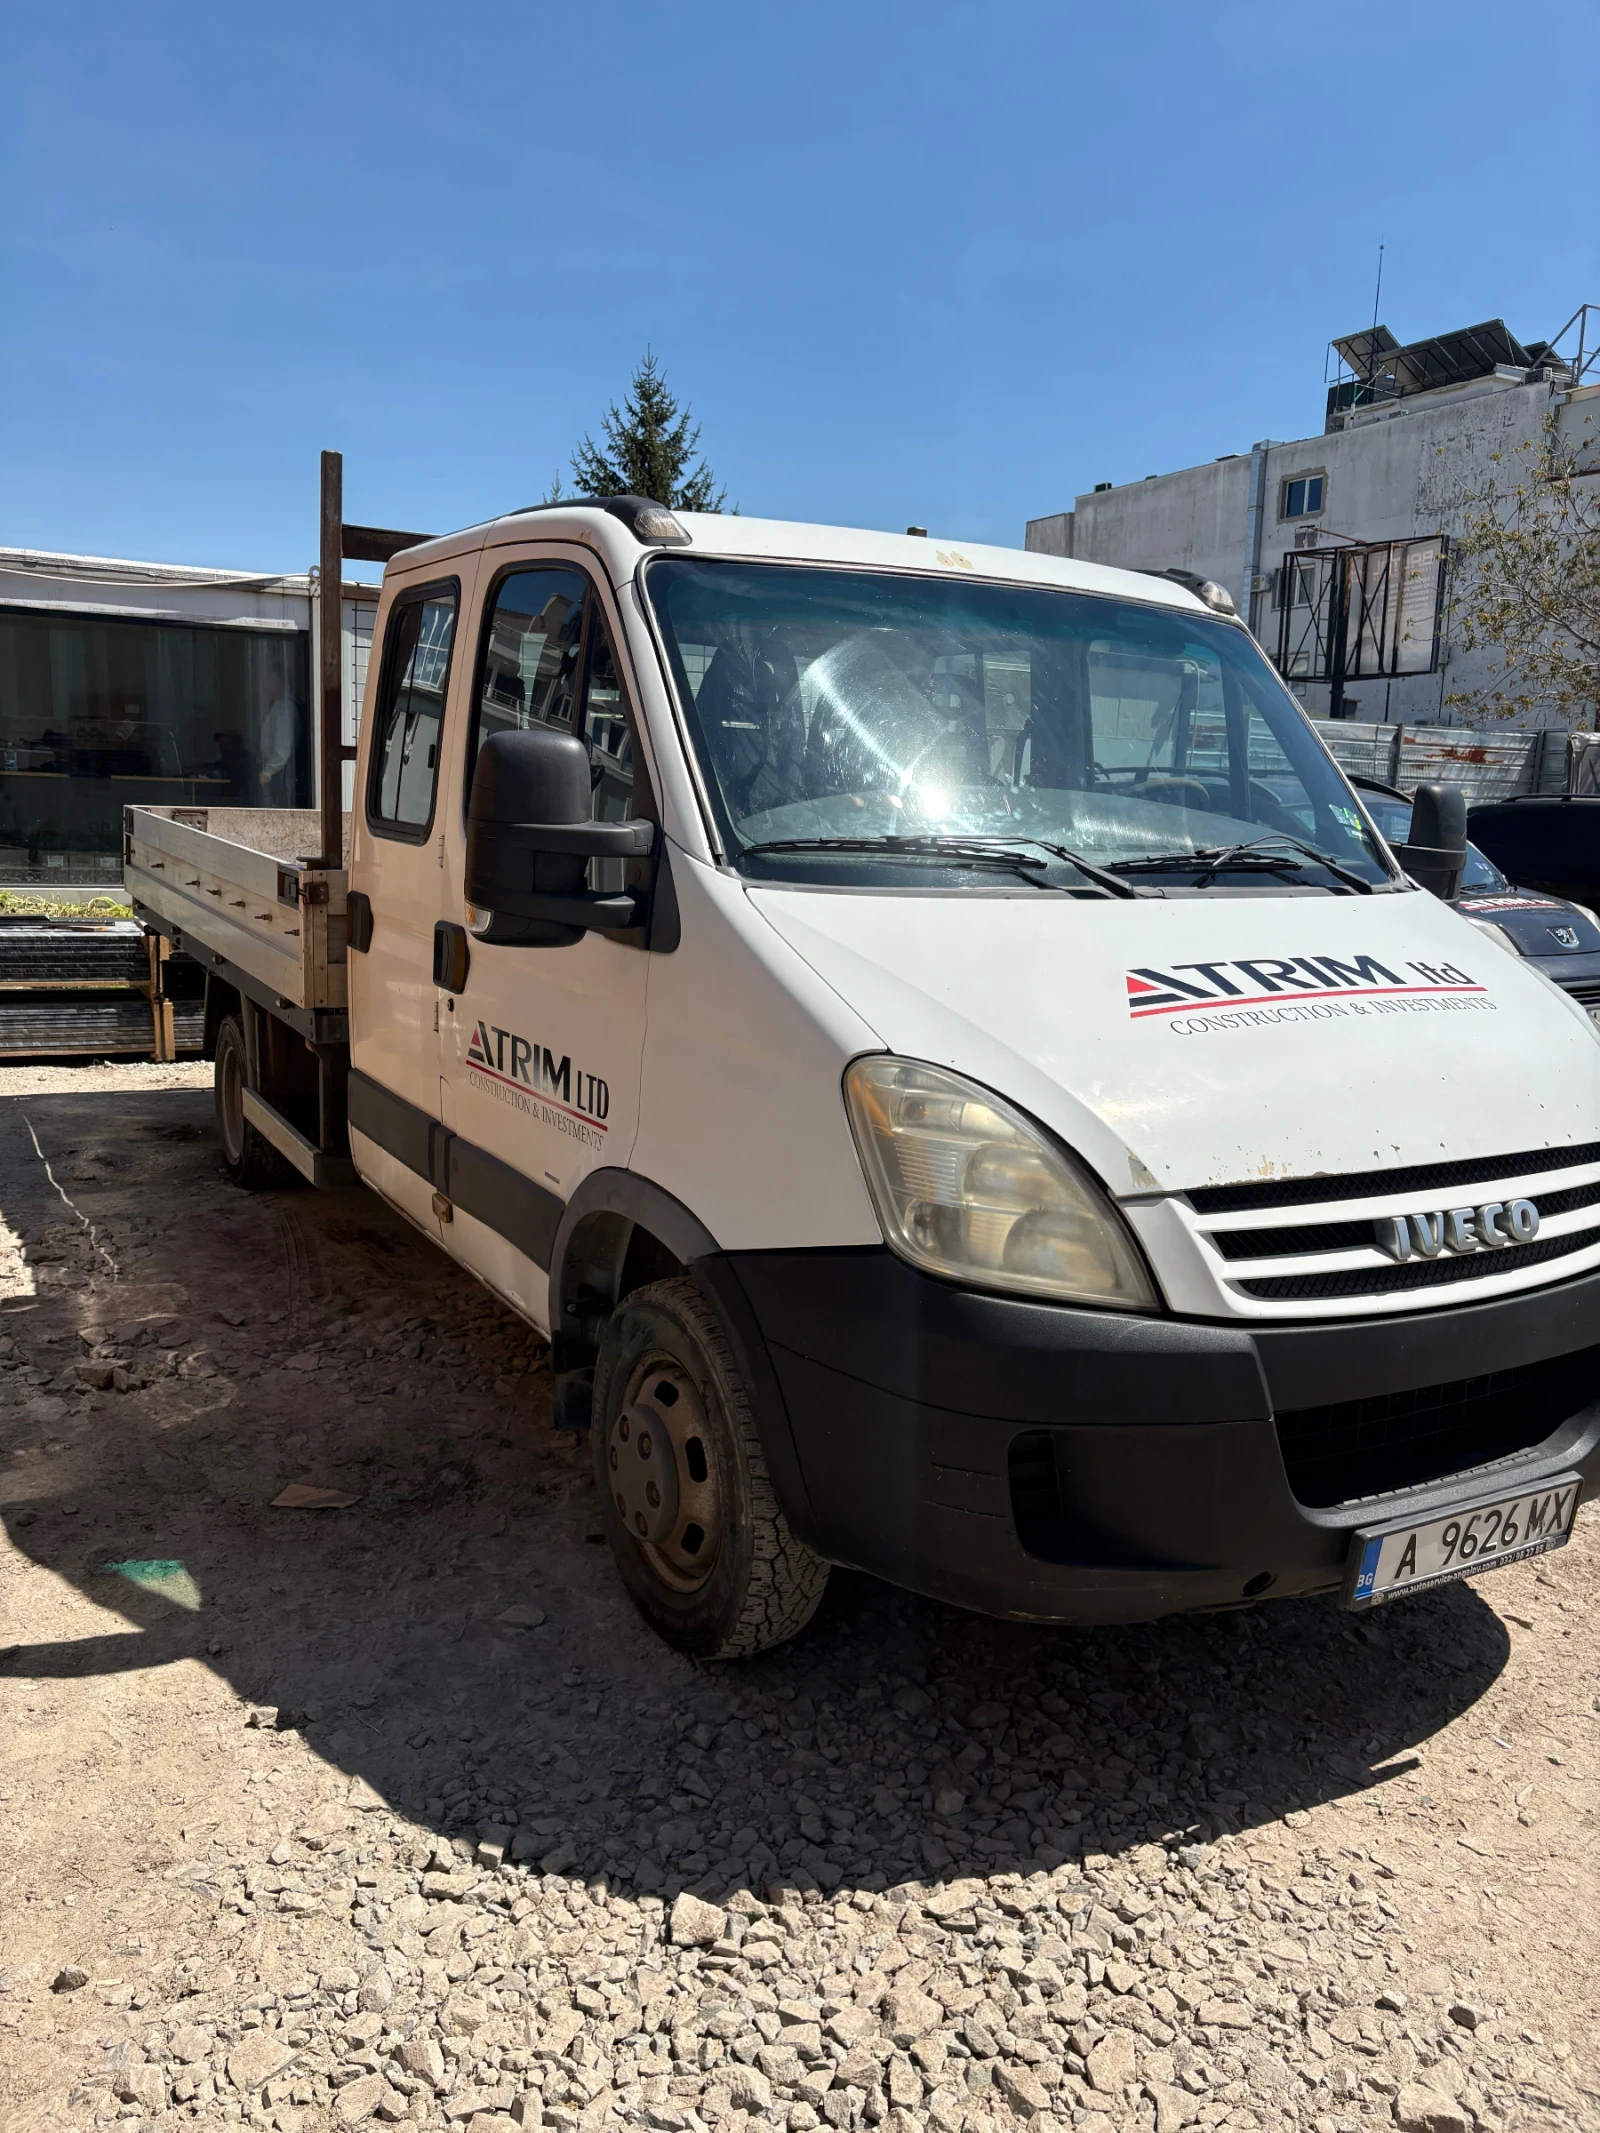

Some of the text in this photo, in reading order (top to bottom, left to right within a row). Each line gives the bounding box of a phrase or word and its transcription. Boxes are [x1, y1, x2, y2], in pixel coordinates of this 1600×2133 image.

[1126, 955, 1478, 1008] ATRIM ltd
[1170, 997, 1498, 1036] CONSTRUCTION & INVESTMENTS
[467, 1019, 610, 1120] ATRIM LTD
[469, 1071, 605, 1152] CONSTRUCTION & INVESTMENTS
[1390, 1198, 1540, 1260] IVECO
[1393, 1488, 1573, 1580] A 9626 MX
[1357, 1572, 1373, 1588] BG
